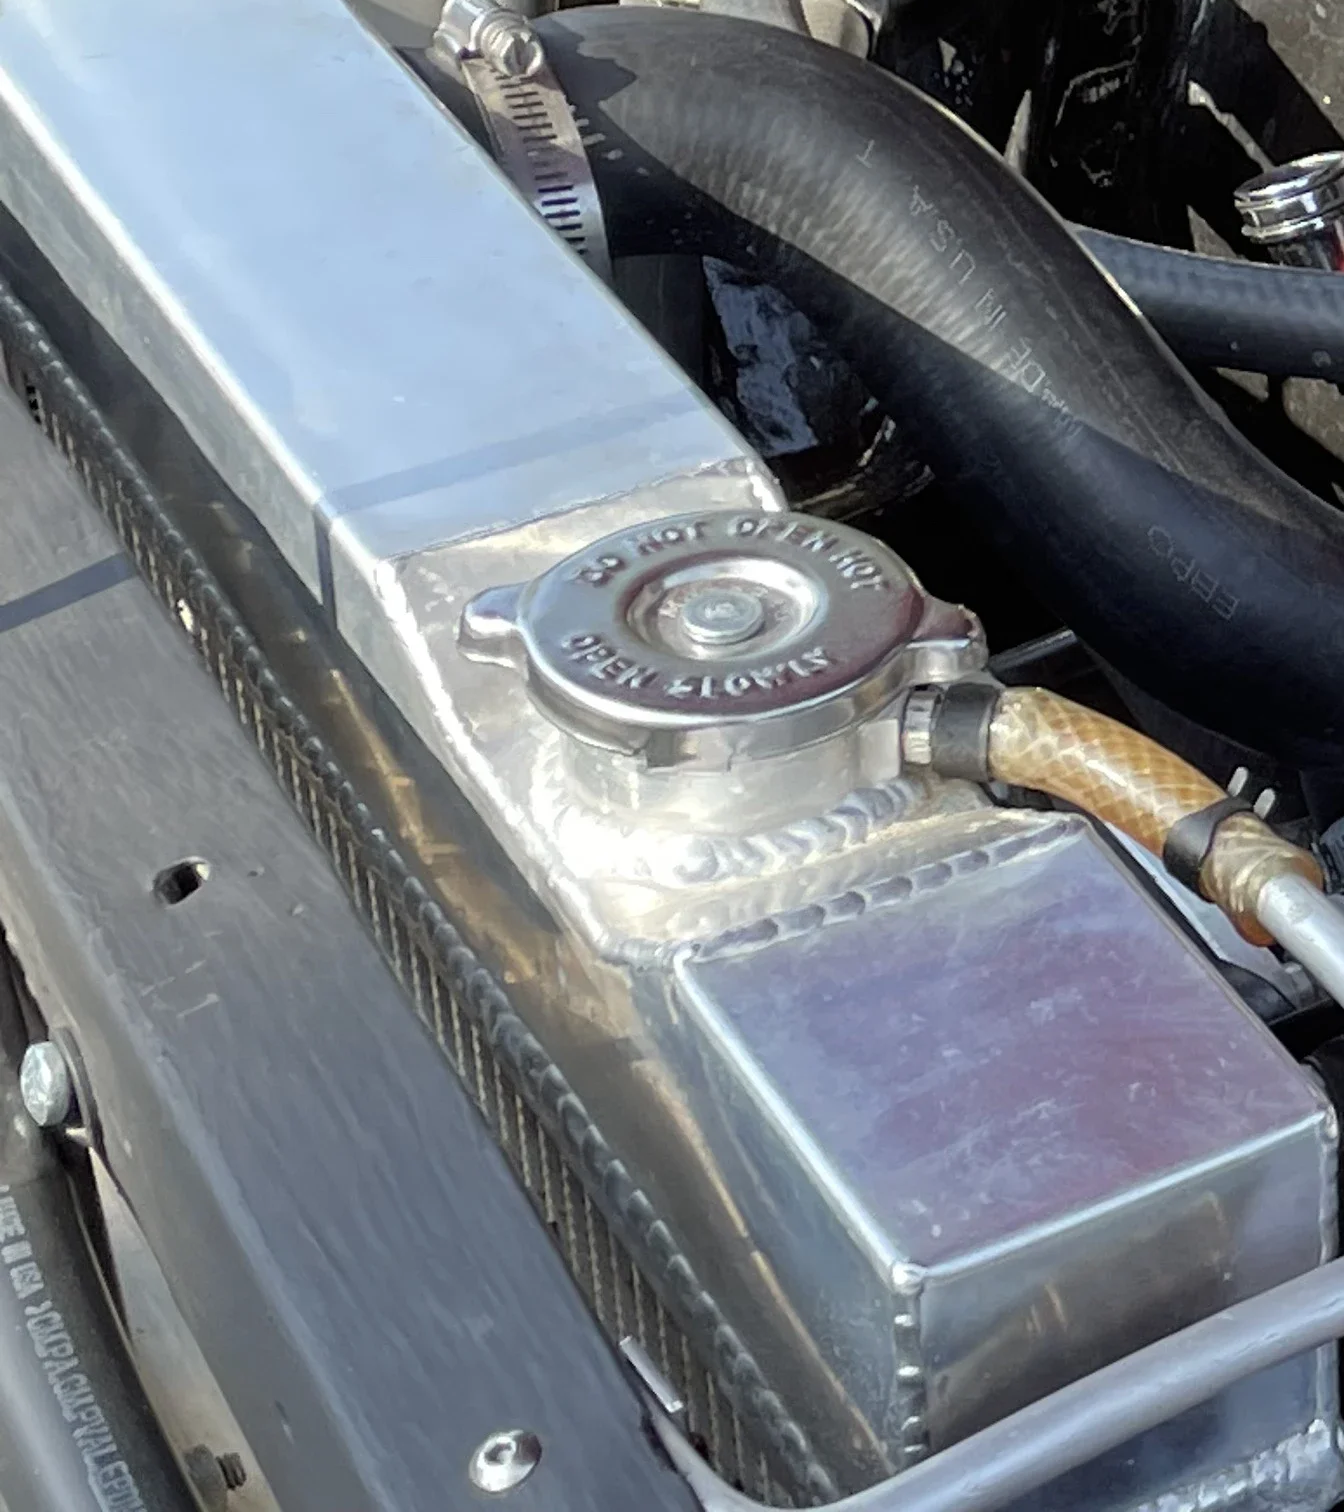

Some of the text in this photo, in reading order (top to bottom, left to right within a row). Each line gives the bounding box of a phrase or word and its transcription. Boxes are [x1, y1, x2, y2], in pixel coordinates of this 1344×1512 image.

[636, 519, 713, 557] NOT
[726, 515, 842, 554] OPEN
[827, 548, 891, 592] HOT
[560, 631, 837, 700] OPEN SLOWLY
